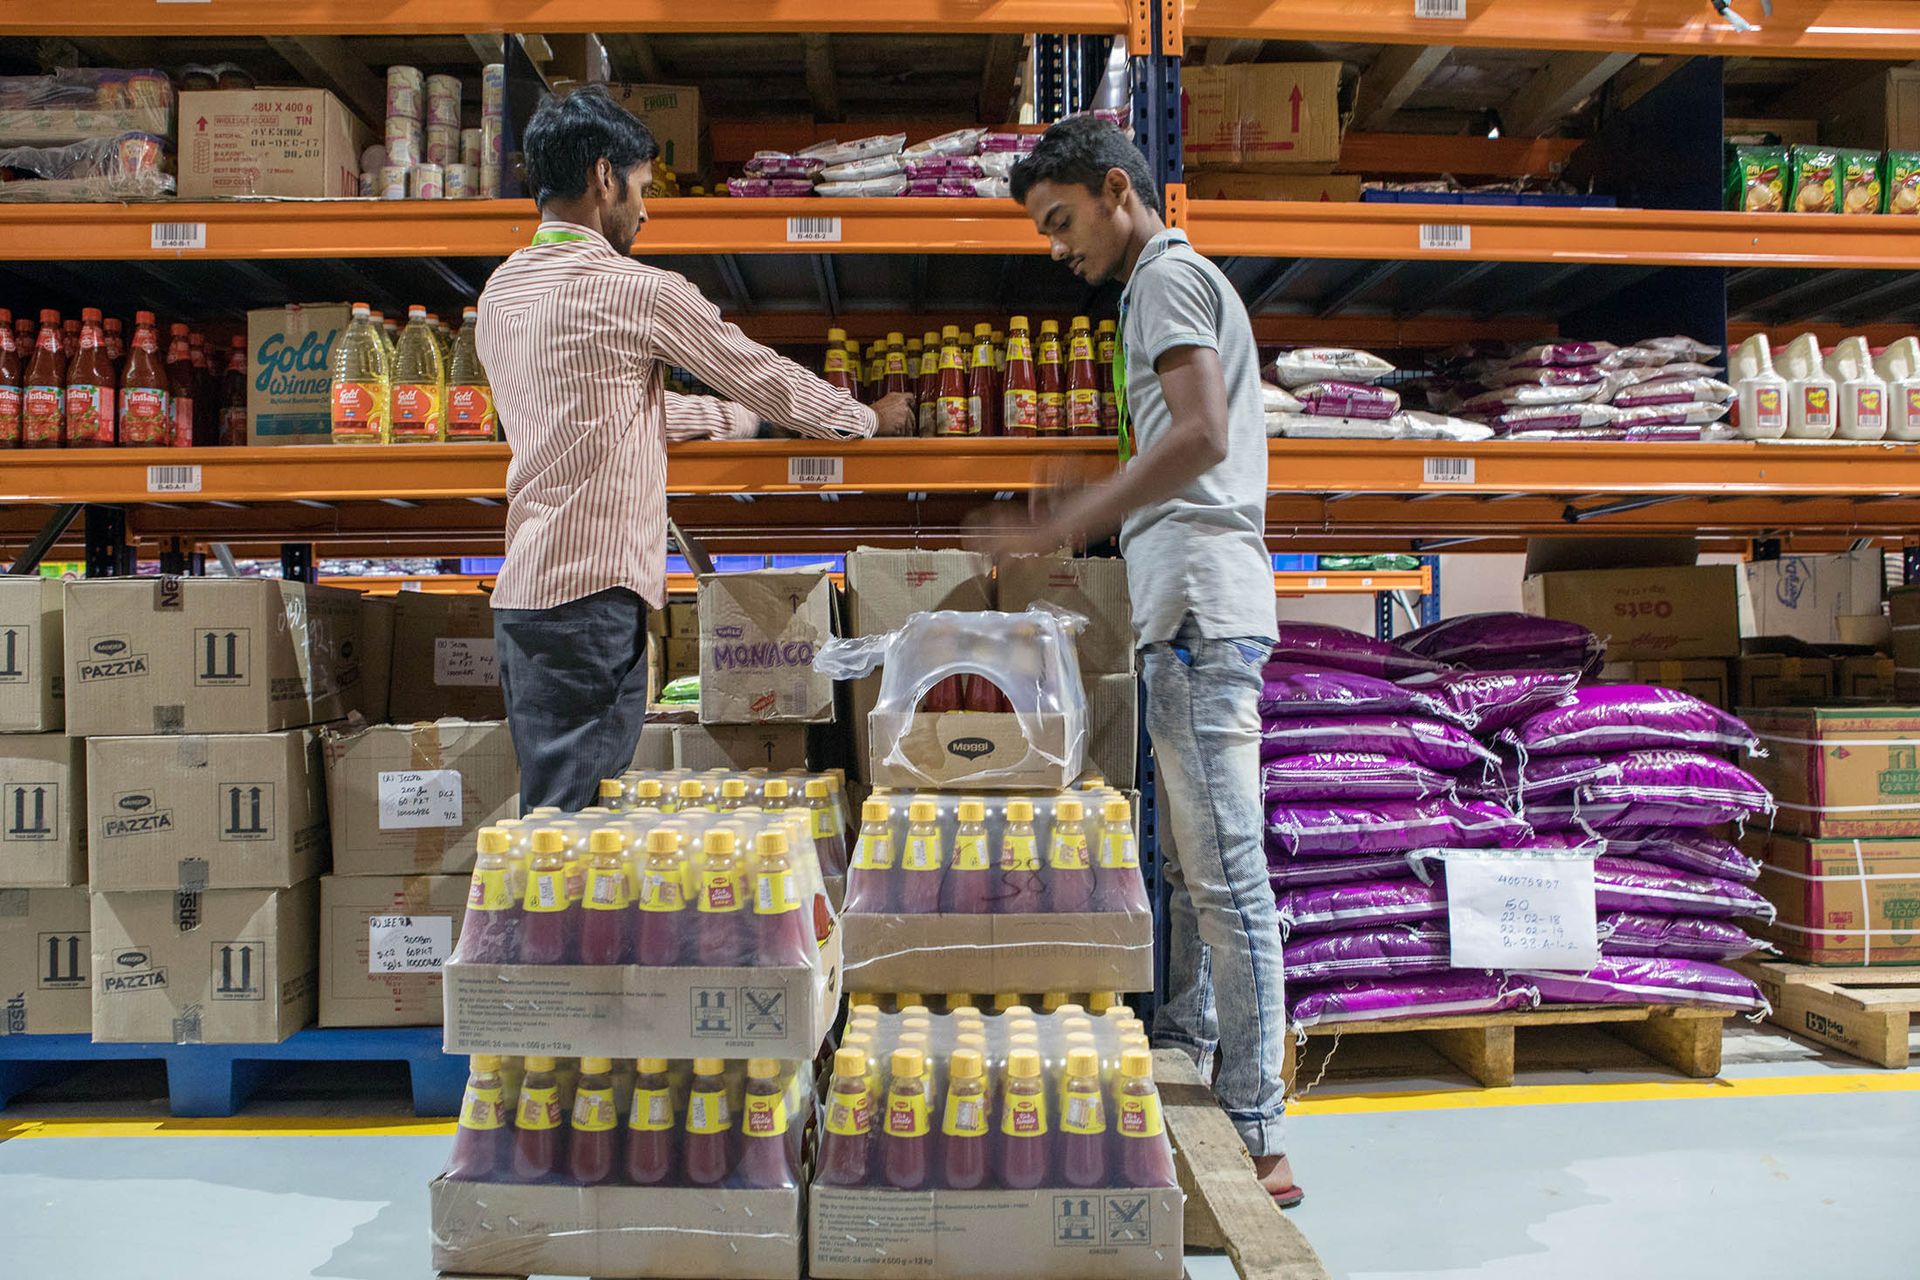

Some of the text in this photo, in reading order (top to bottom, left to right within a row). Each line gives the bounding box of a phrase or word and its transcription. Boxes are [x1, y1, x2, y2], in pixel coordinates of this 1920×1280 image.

[251, 102, 313, 114] 48U X 400 g
[296, 116, 313, 126] TIN
[161, 239, 190, 248] B-40-B-1
[256, 329, 337, 391] Gold
[340, 389, 359, 398] Gold
[398, 390, 417, 400] Gold
[454, 391, 473, 401] Gold
[1614, 600, 1673, 618] Oats
[714, 641, 815, 672] MONACO
[81, 659, 146, 680] PAZZTA
[953, 742, 988, 752] Maggi
[1309, 752, 1372, 764] ROYAL
[1629, 751, 1692, 766] ROYAL
[106, 814, 171, 835] PAZZTA
[1504, 898, 1529, 911] 50
[105, 971, 166, 991] PAZZTA
[1828, 1018, 1843, 1034] big
